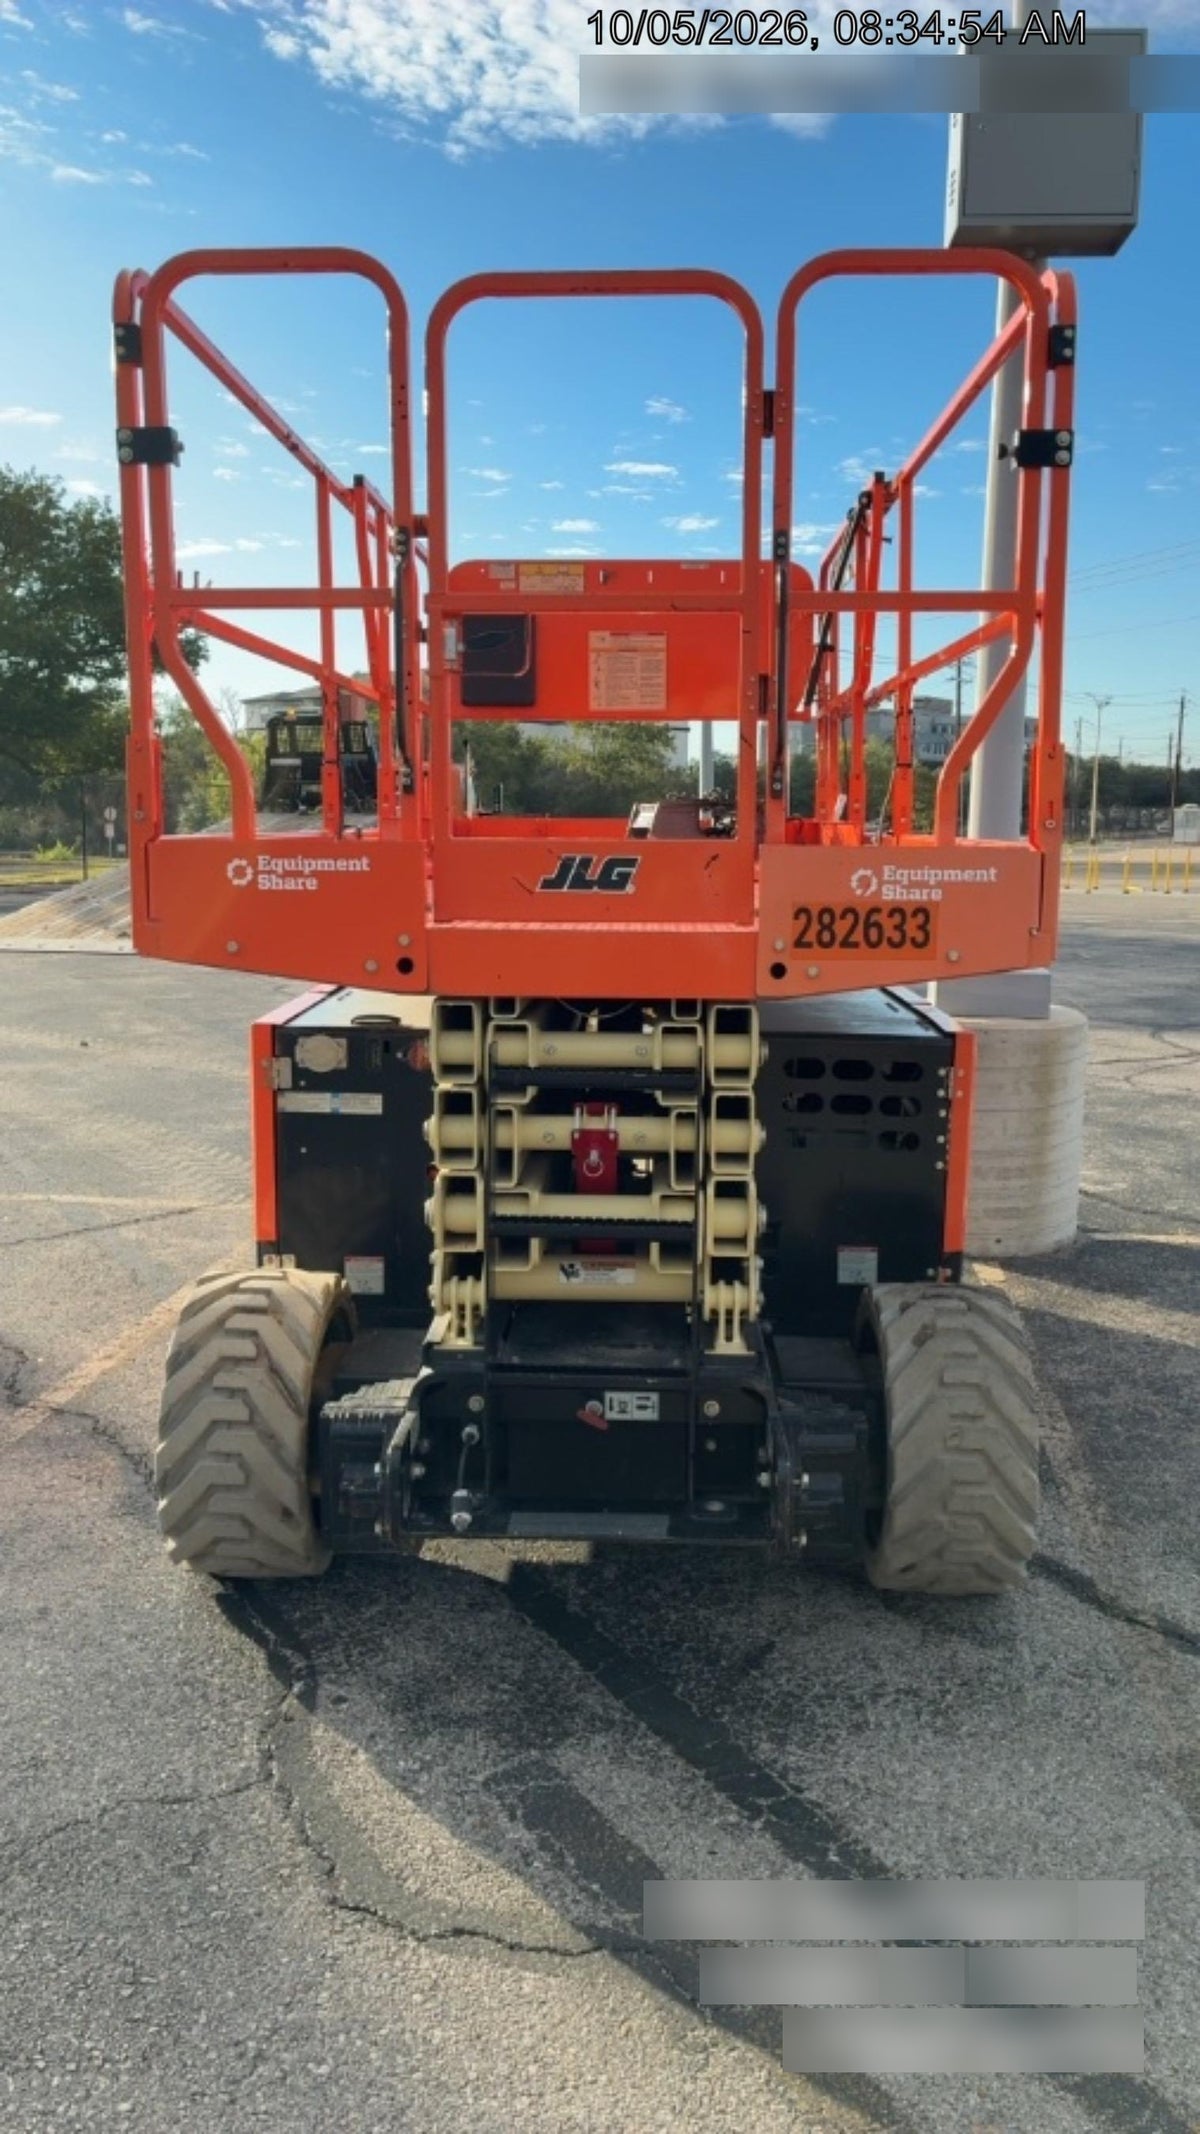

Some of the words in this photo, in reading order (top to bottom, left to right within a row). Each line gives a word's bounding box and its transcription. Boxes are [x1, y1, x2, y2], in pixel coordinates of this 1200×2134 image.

[257, 855, 370, 874] Equipment
[535, 853, 641, 894] JLG
[257, 874, 319, 890] Share
[882, 865, 998, 884] Equipment
[881, 884, 942, 901] Share
[793, 907, 931, 949] 282633
